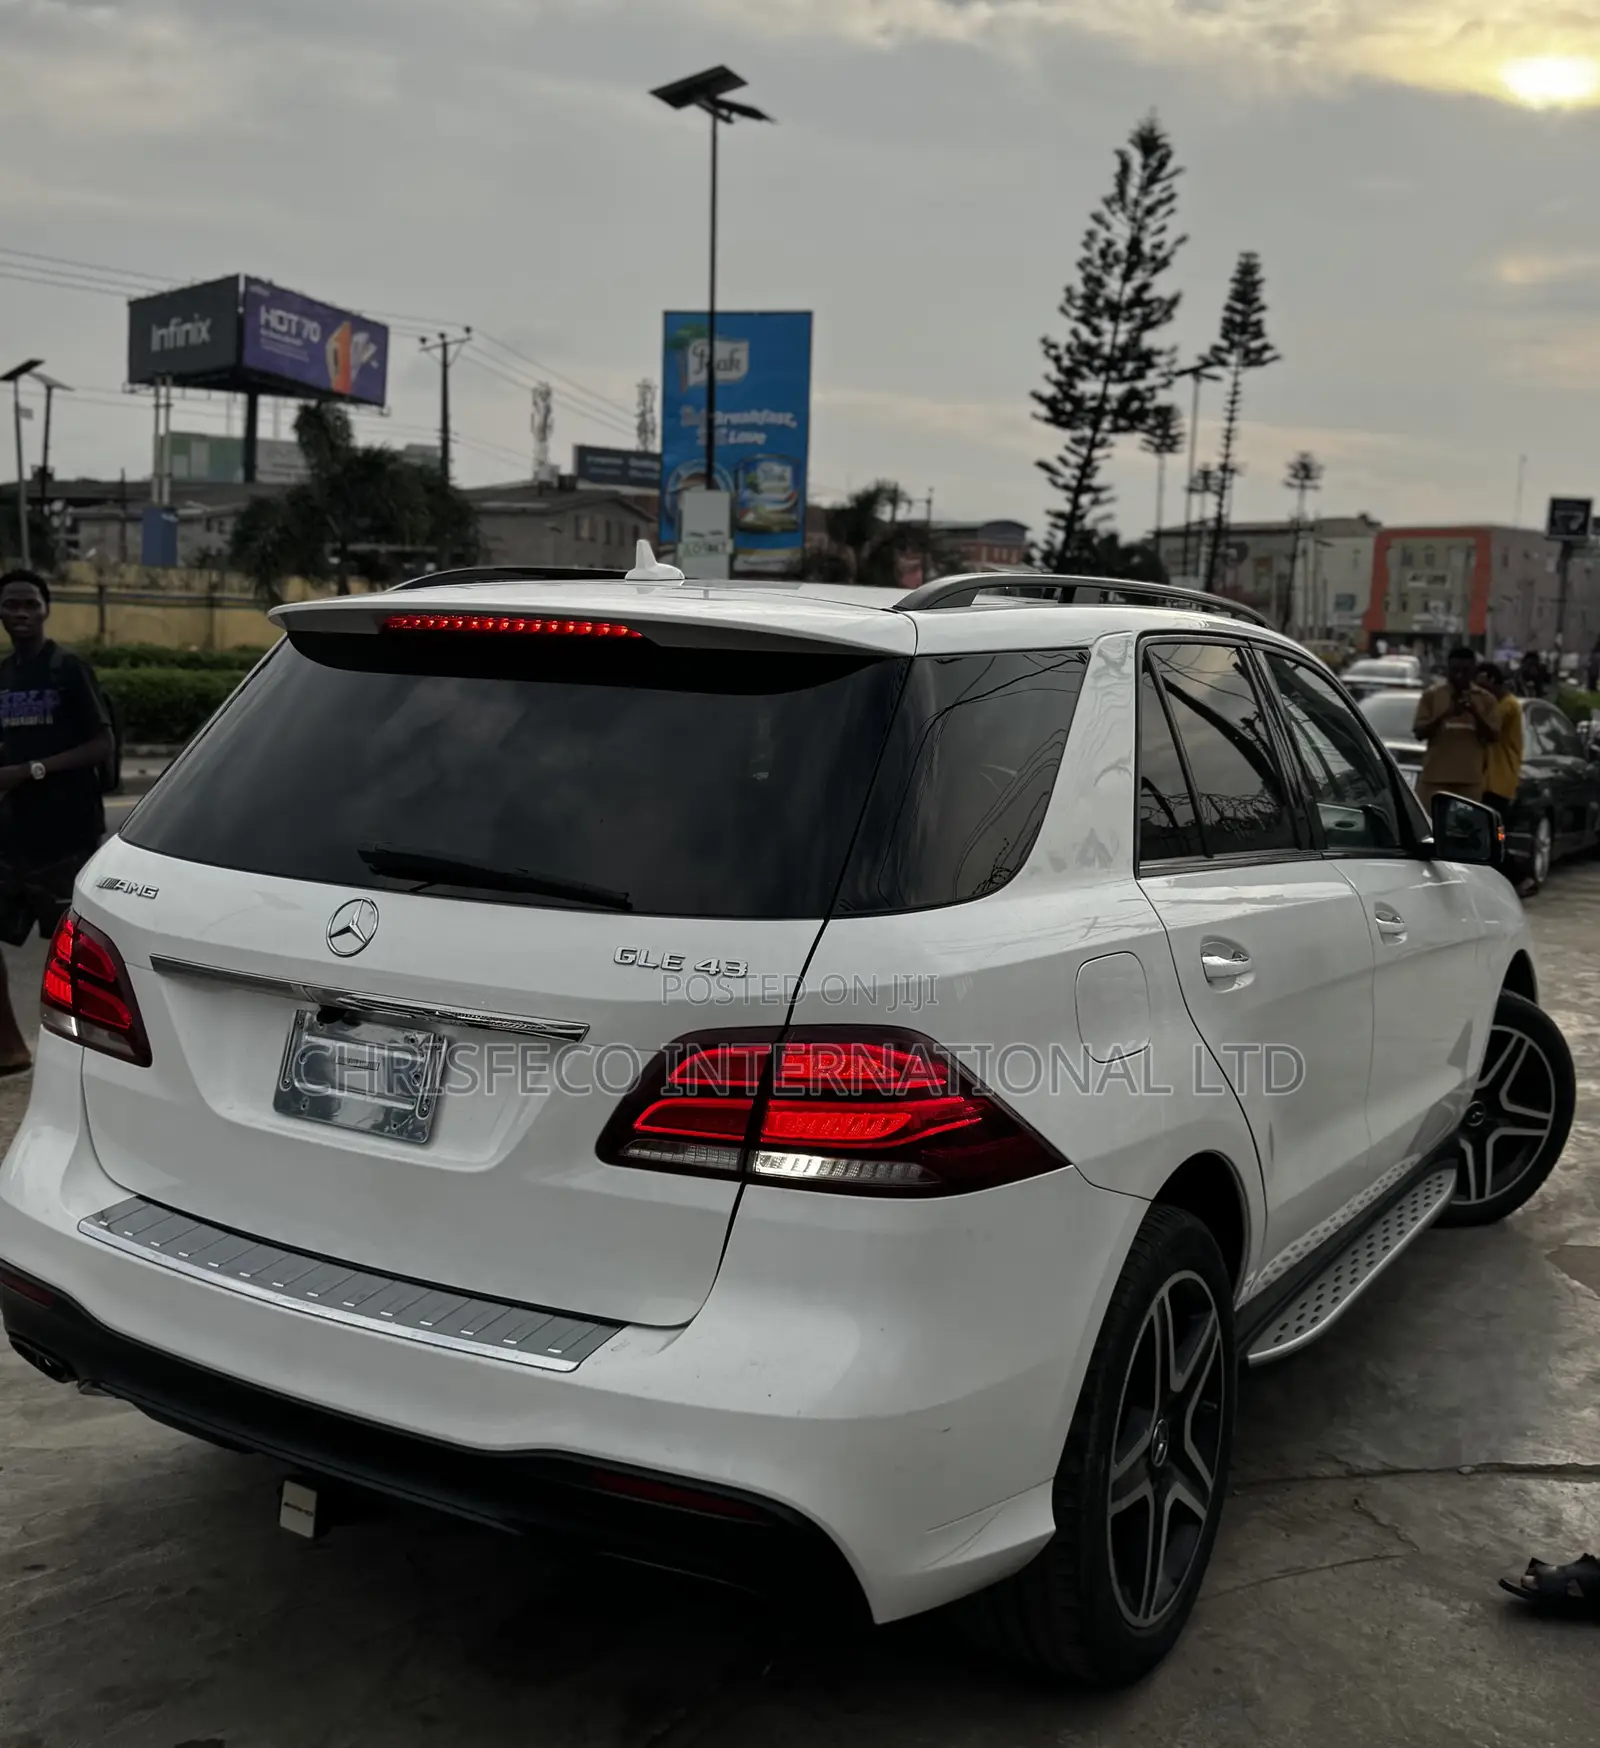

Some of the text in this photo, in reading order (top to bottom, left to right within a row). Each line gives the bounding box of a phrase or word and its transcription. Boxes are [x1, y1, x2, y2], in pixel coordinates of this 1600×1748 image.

[151, 313, 211, 352] Infinix
[260, 305, 298, 334] HOT
[112, 878, 160, 900] AMG
[613, 946, 749, 979] GLE 43
